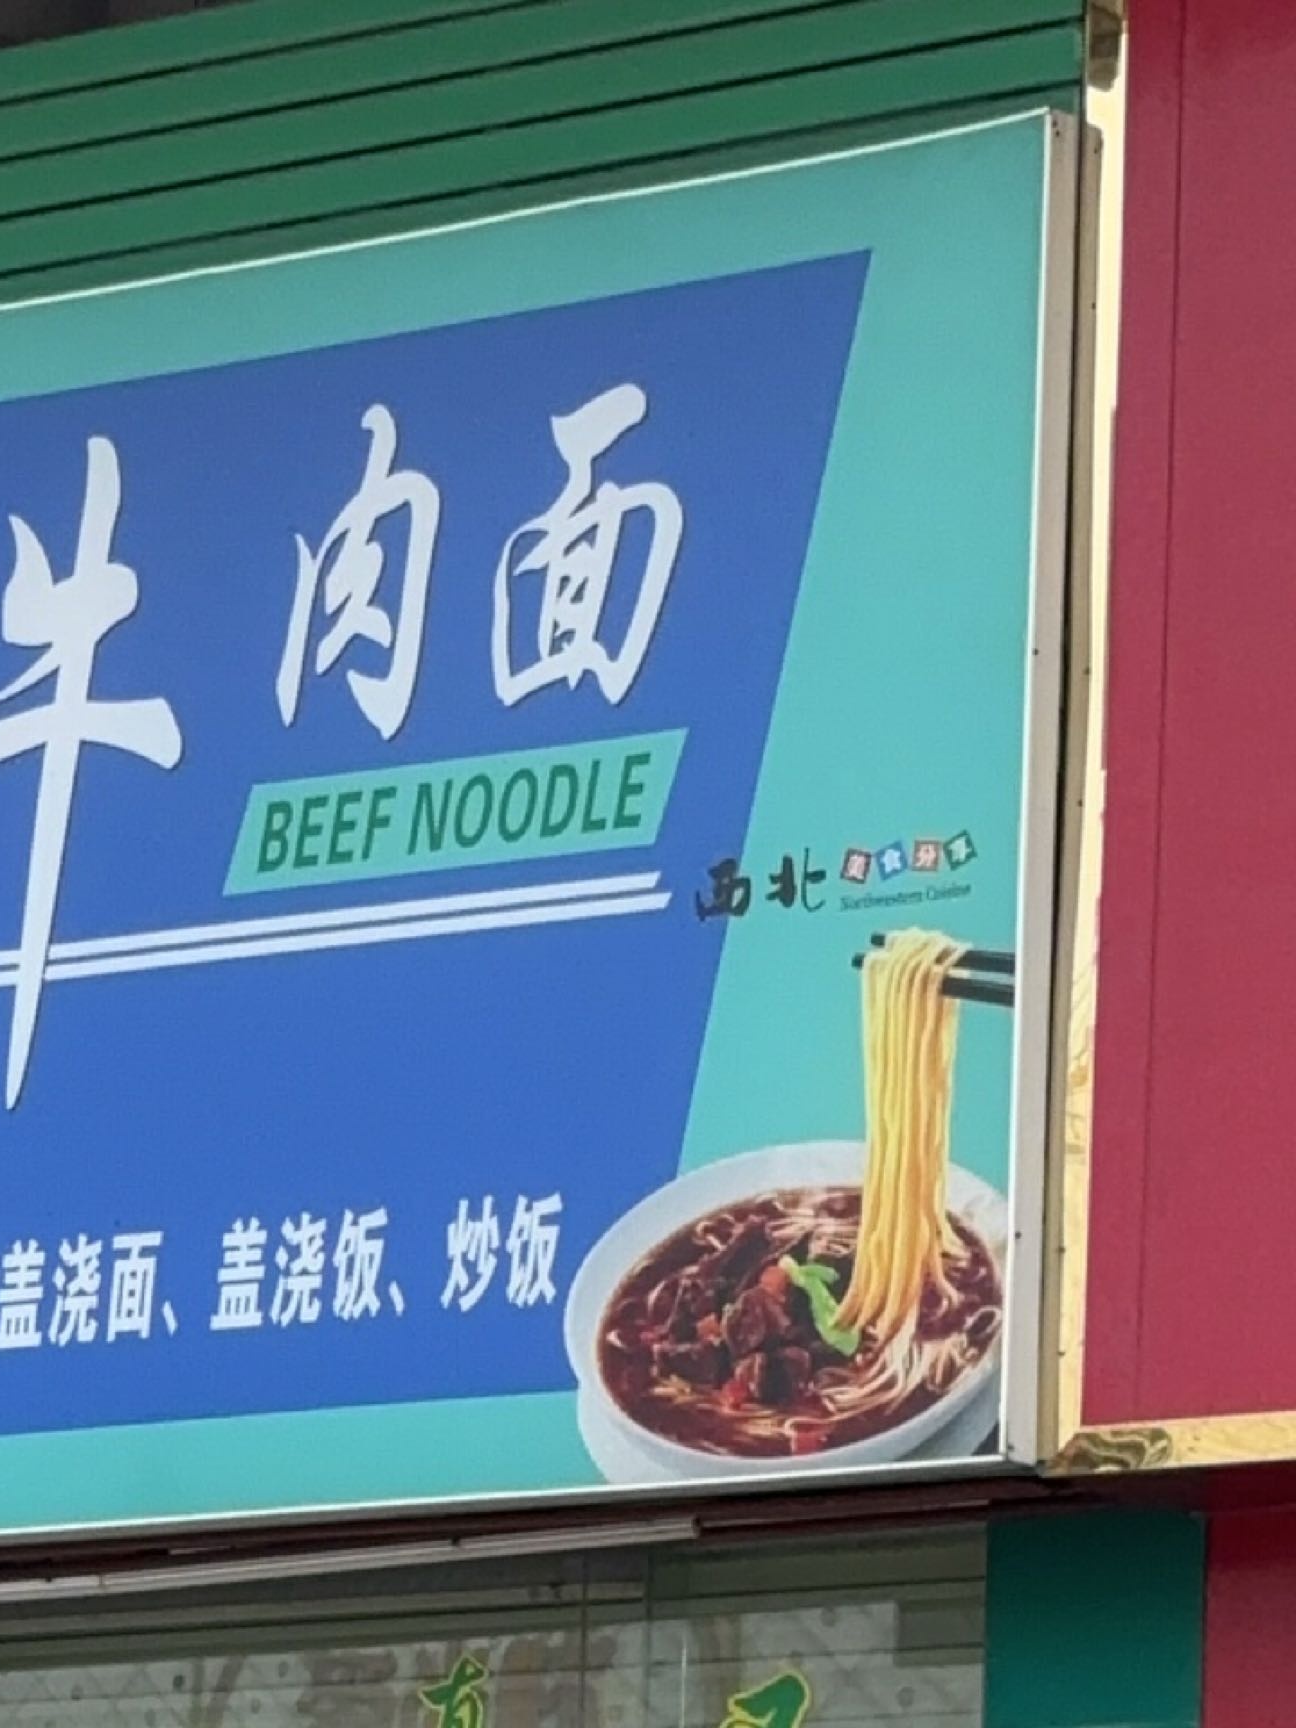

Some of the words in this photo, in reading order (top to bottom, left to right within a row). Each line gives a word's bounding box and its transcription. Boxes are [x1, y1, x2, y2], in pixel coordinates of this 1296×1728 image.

[257, 786, 396, 873] BEEF
[407, 753, 651, 854] NOODLE
[695, 848, 827, 922] 西北
